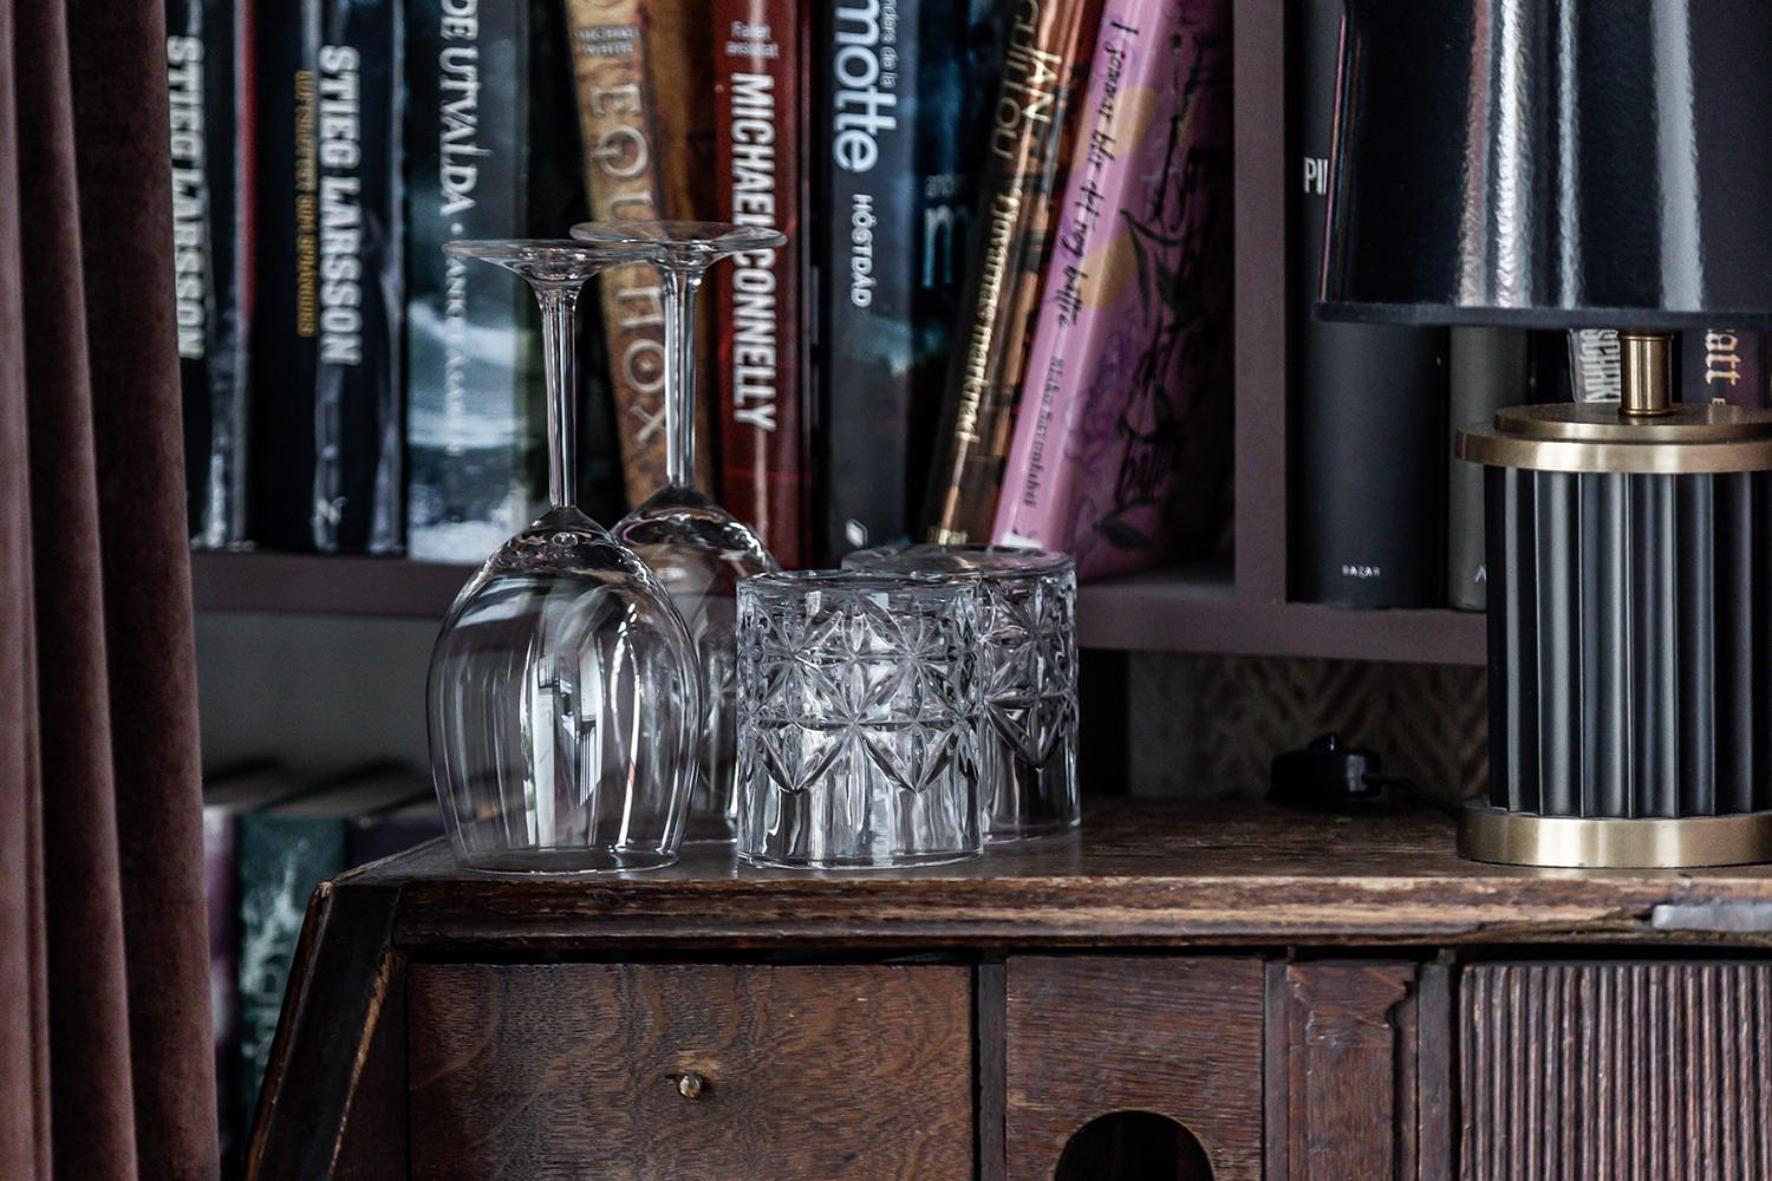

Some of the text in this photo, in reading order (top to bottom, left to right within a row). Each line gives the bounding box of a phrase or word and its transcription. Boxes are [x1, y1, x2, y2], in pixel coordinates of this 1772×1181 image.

[880, 47, 899, 70] de
[1110, 20, 1140, 35] I
[833, 0, 898, 172] motte
[880, 72, 899, 88] la
[1020, 46, 1063, 123] JAN
[1098, 41, 1126, 122] sommar
[440, 46, 493, 217] UTVALDA
[731, 73, 776, 228] MICHAEL
[1086, 129, 1117, 168] blir
[167, 35, 204, 359] STIEG LARSSON
[319, 45, 362, 365] STIEG LARSSON
[1074, 180, 1105, 231] det
[850, 194, 877, 307] HÖSTDÅD
[1059, 218, 1088, 258] nog
[731, 245, 776, 432] CONNELLY
[1705, 329, 1742, 386] att
[955, 324, 991, 443] marknad
